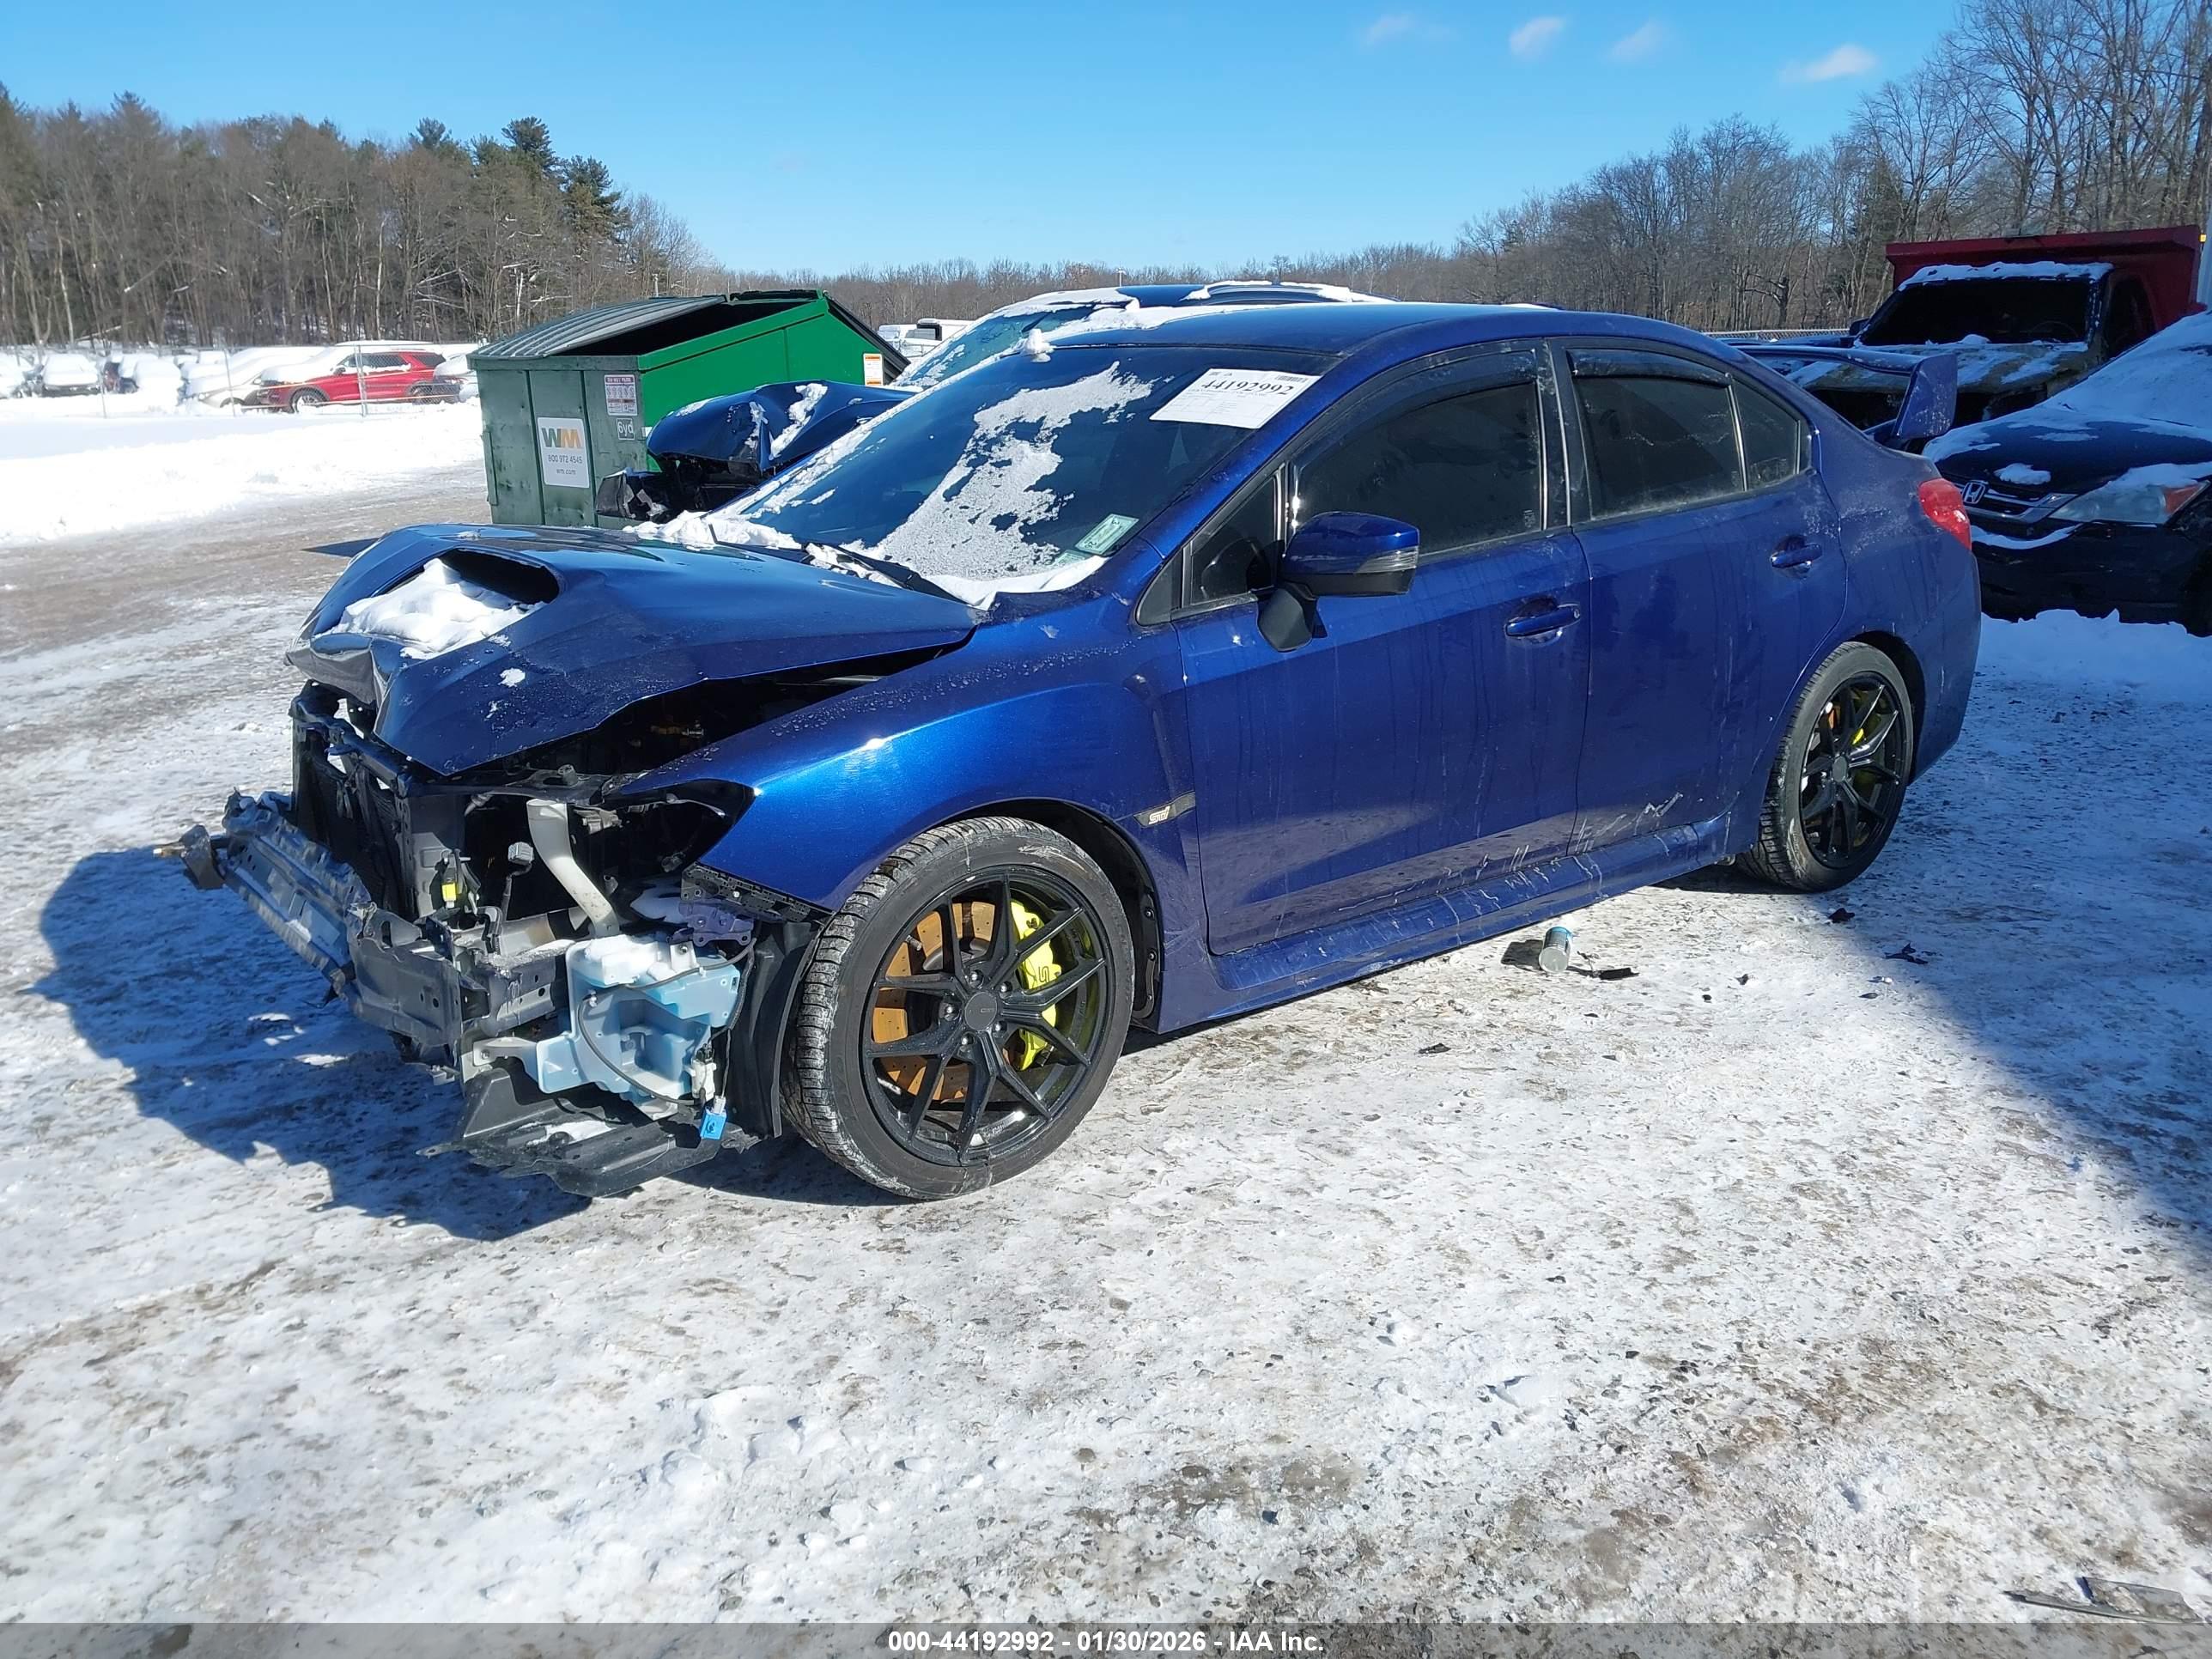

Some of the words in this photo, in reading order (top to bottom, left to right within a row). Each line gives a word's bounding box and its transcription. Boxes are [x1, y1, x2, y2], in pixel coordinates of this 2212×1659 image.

[1202, 380, 1294, 395] 44192992
[618, 421, 634, 436] 6yd
[540, 428, 582, 447] WM
